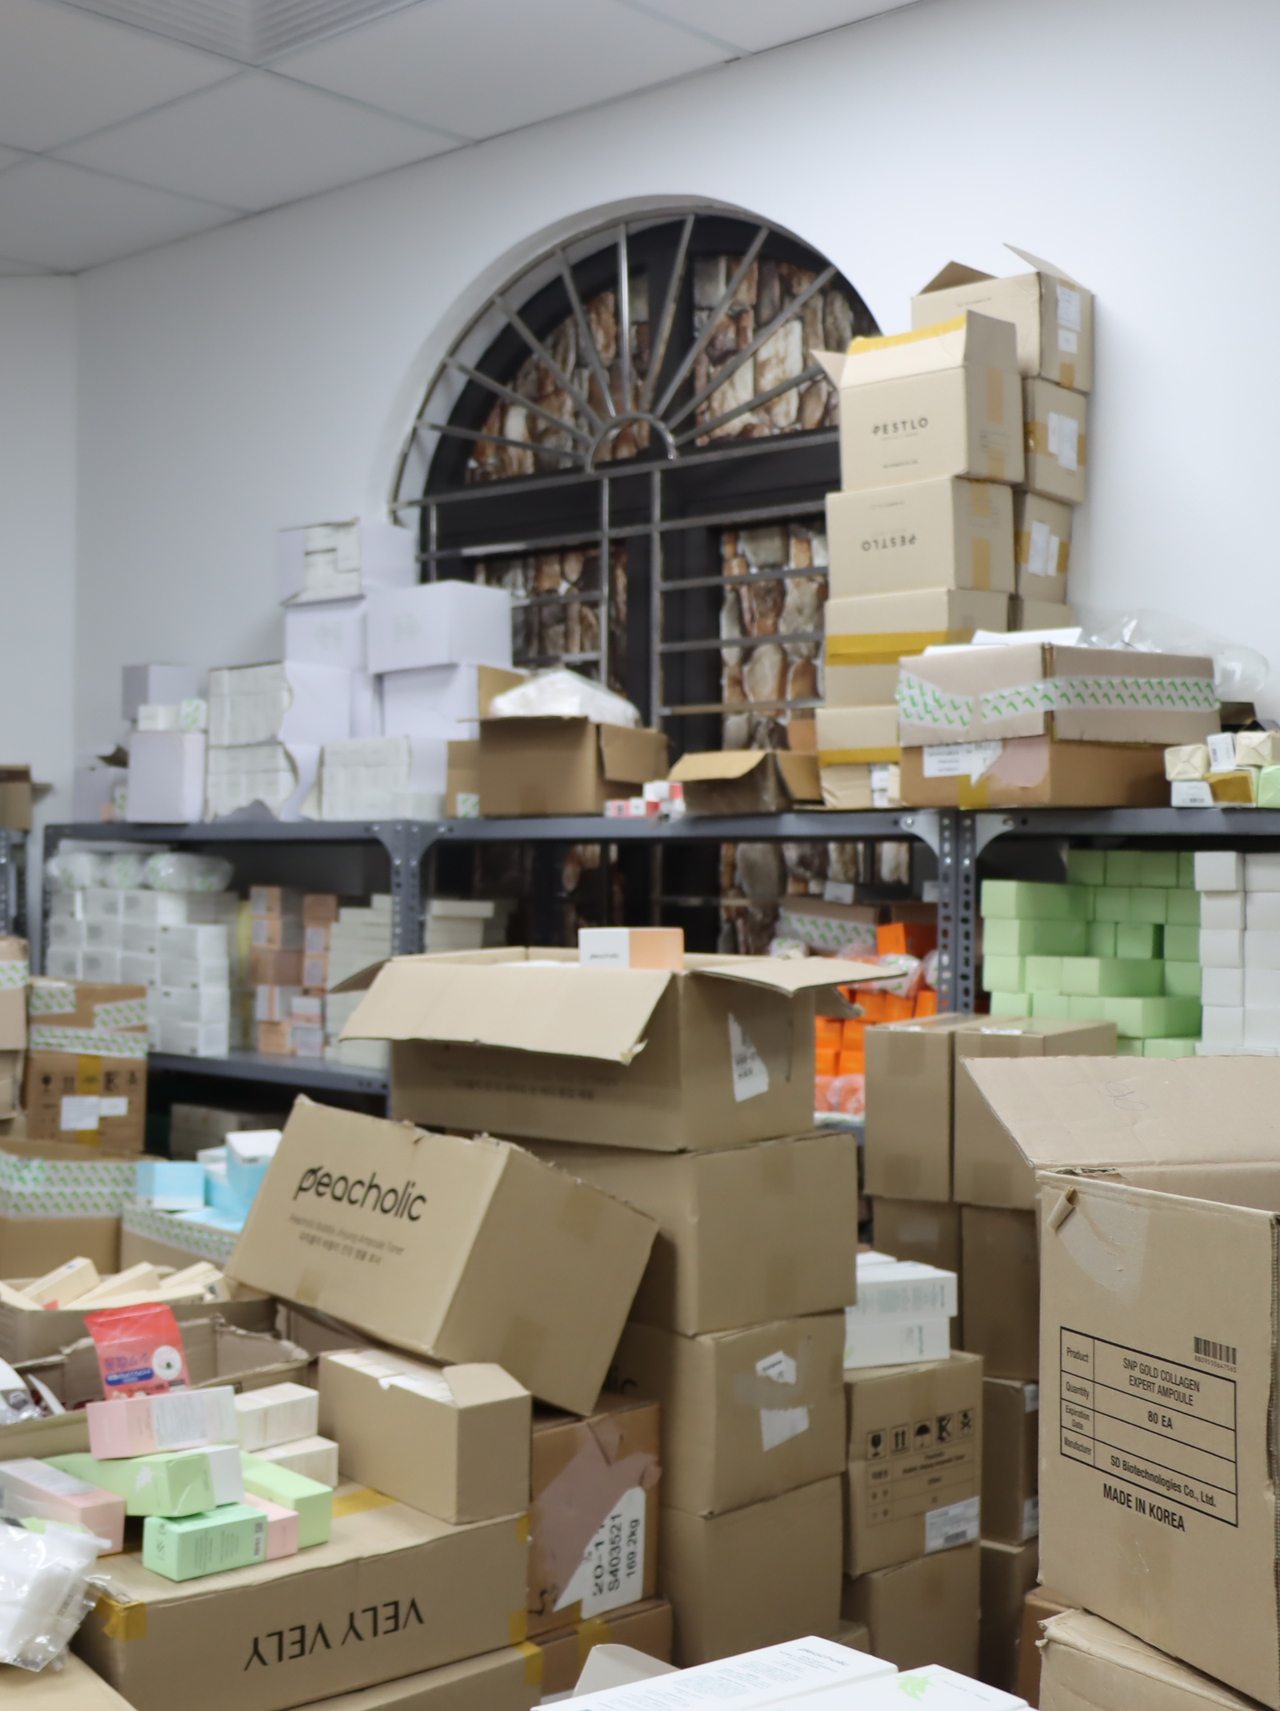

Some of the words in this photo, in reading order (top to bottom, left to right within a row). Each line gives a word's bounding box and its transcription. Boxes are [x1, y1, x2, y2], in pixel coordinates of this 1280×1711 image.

[872, 417, 929, 436] PESTLO
[861, 534, 917, 551] PESTLO
[293, 1166, 427, 1222] peacholic
[1066, 1346, 1089, 1363] Product
[1123, 1357, 1138, 1372] SNP
[1139, 1363, 1159, 1379] GOLD
[1160, 1369, 1200, 1393] COLLAGEN
[1065, 1381, 1090, 1400] Quantity
[1129, 1375, 1156, 1395] EXPERT
[1157, 1384, 1194, 1406] AMPOULE
[1065, 1404, 1090, 1421] Expiration
[1071, 1418, 1084, 1430] Date
[1147, 1410, 1159, 1424] 80
[1161, 1415, 1173, 1430] EA
[1063, 1436, 1092, 1455] Manufacturer
[1110, 1455, 1121, 1468] SD
[1122, 1460, 1182, 1494] Biotechnologies
[1183, 1484, 1199, 1502] Co.,
[1200, 1491, 1217, 1507] Ltd.
[1103, 1483, 1133, 1510] MADE
[1135, 1496, 1146, 1515] IN
[1148, 1502, 1186, 1532] KOREA
[607, 1513, 623, 1592] S403521
[342, 1597, 425, 1646] VELY
[243, 1621, 332, 1672] VELY
